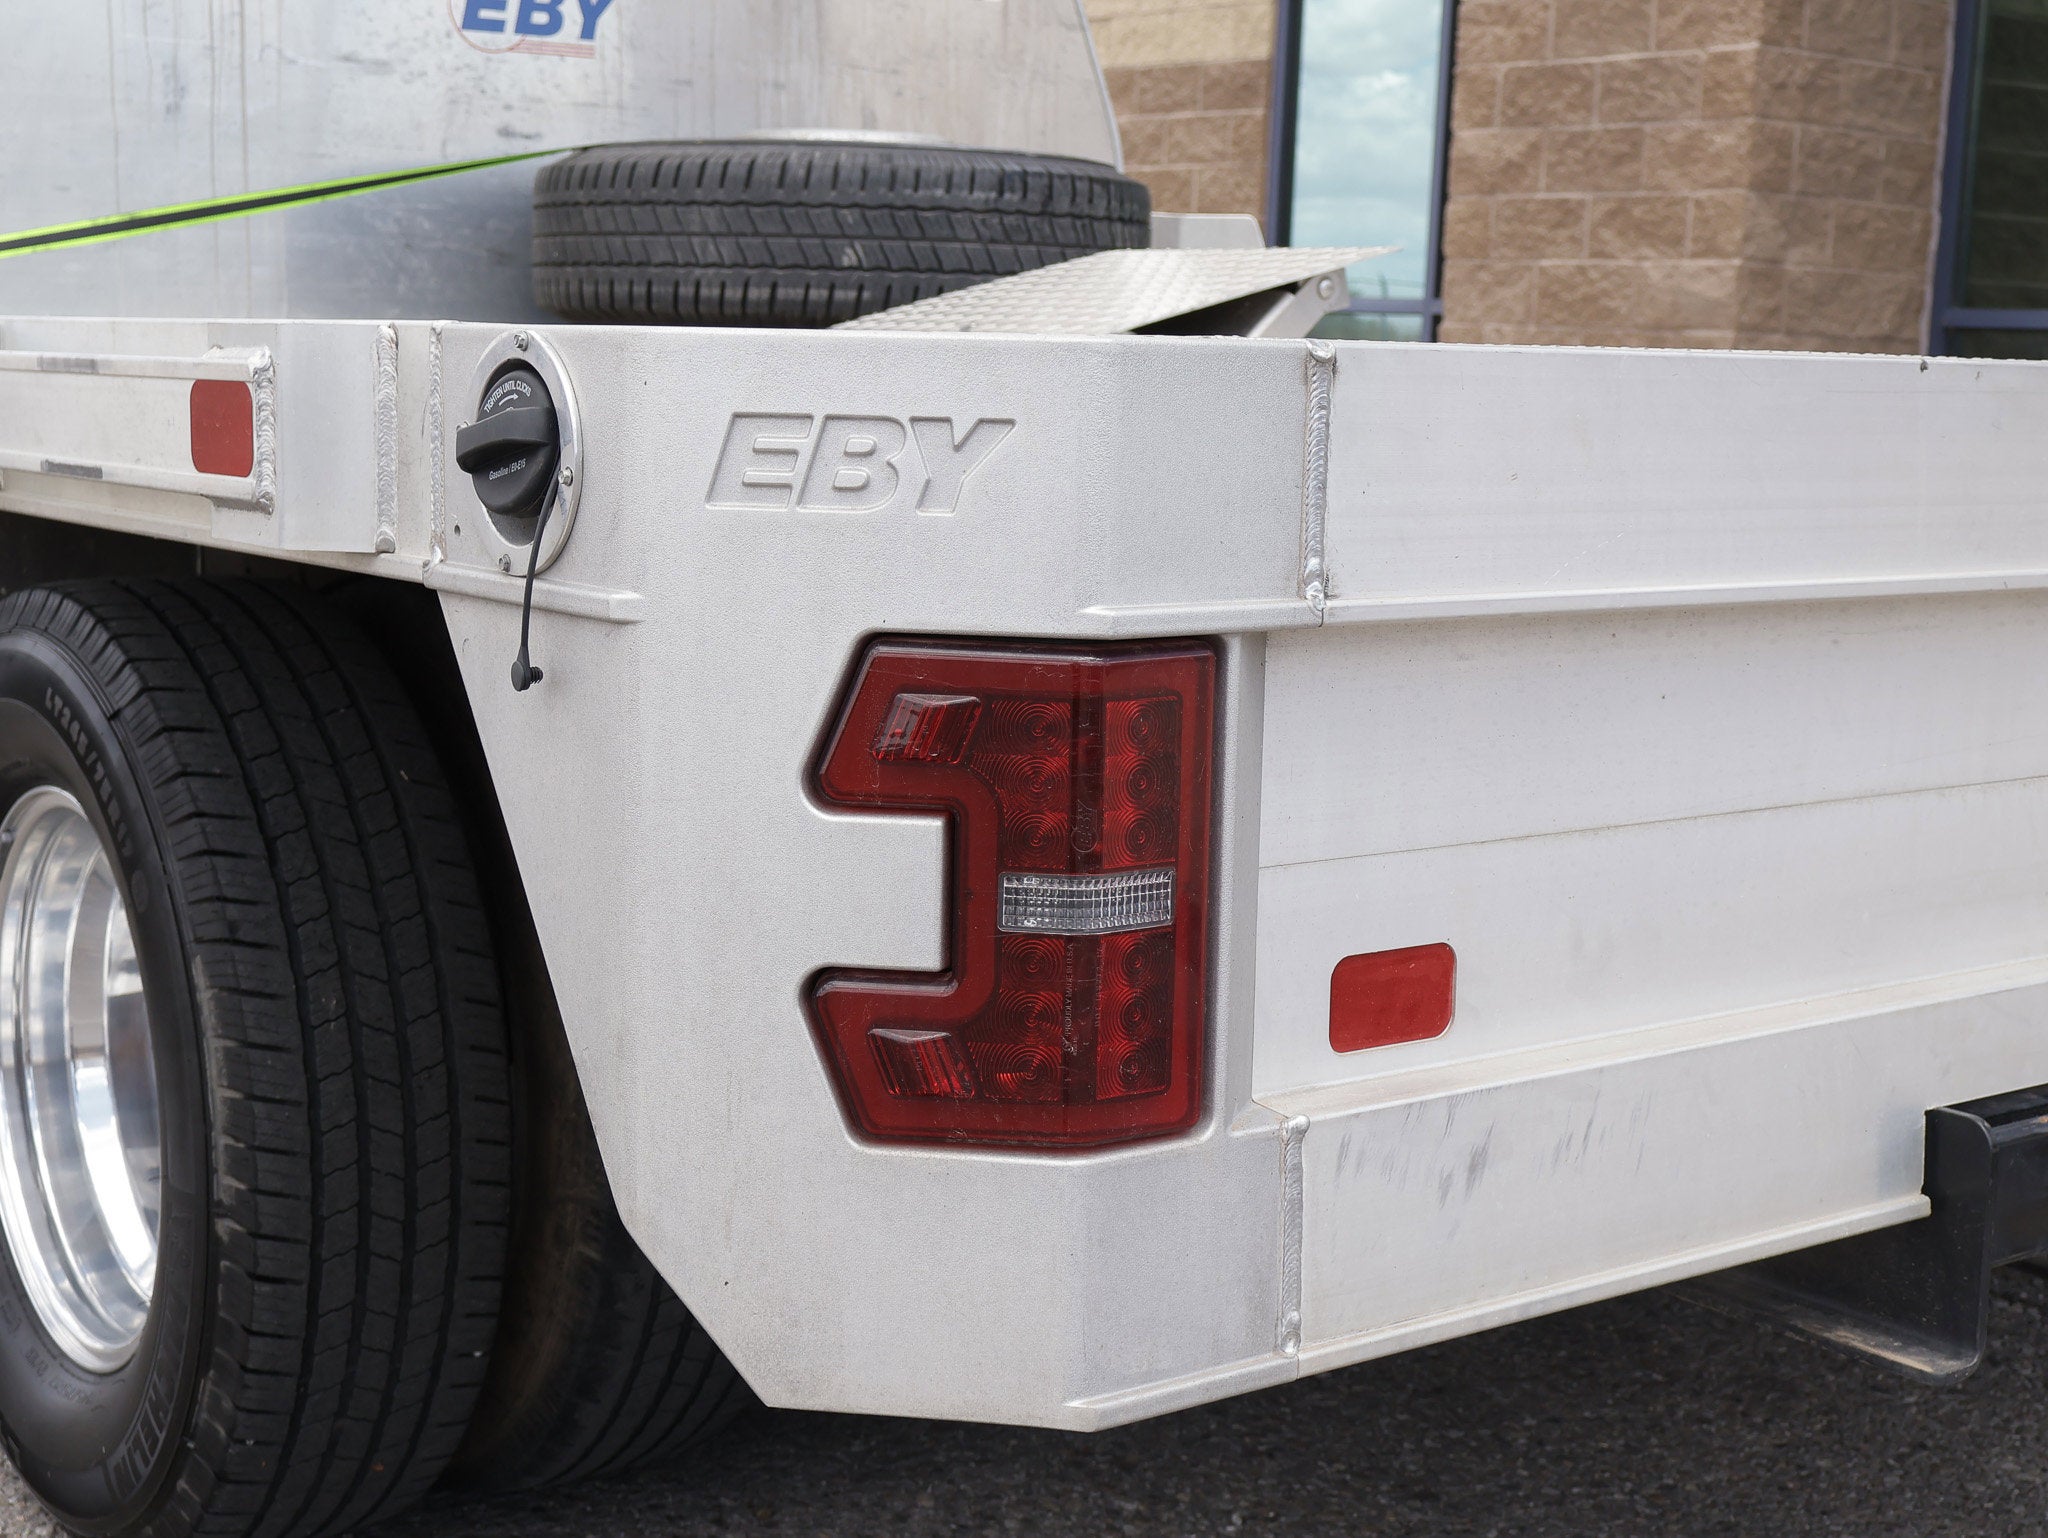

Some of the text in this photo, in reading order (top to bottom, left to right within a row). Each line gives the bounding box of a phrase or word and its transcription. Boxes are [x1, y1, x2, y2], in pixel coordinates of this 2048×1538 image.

[462, 0, 616, 40] EBY
[484, 380, 532, 413] TIGHTEN UNTIL CLICKS
[489, 467, 508, 481] Gasoline
[704, 411, 1017, 517] EBY
[1065, 974, 1073, 997] MADE
[1064, 998, 1072, 1037] PROUDLY
